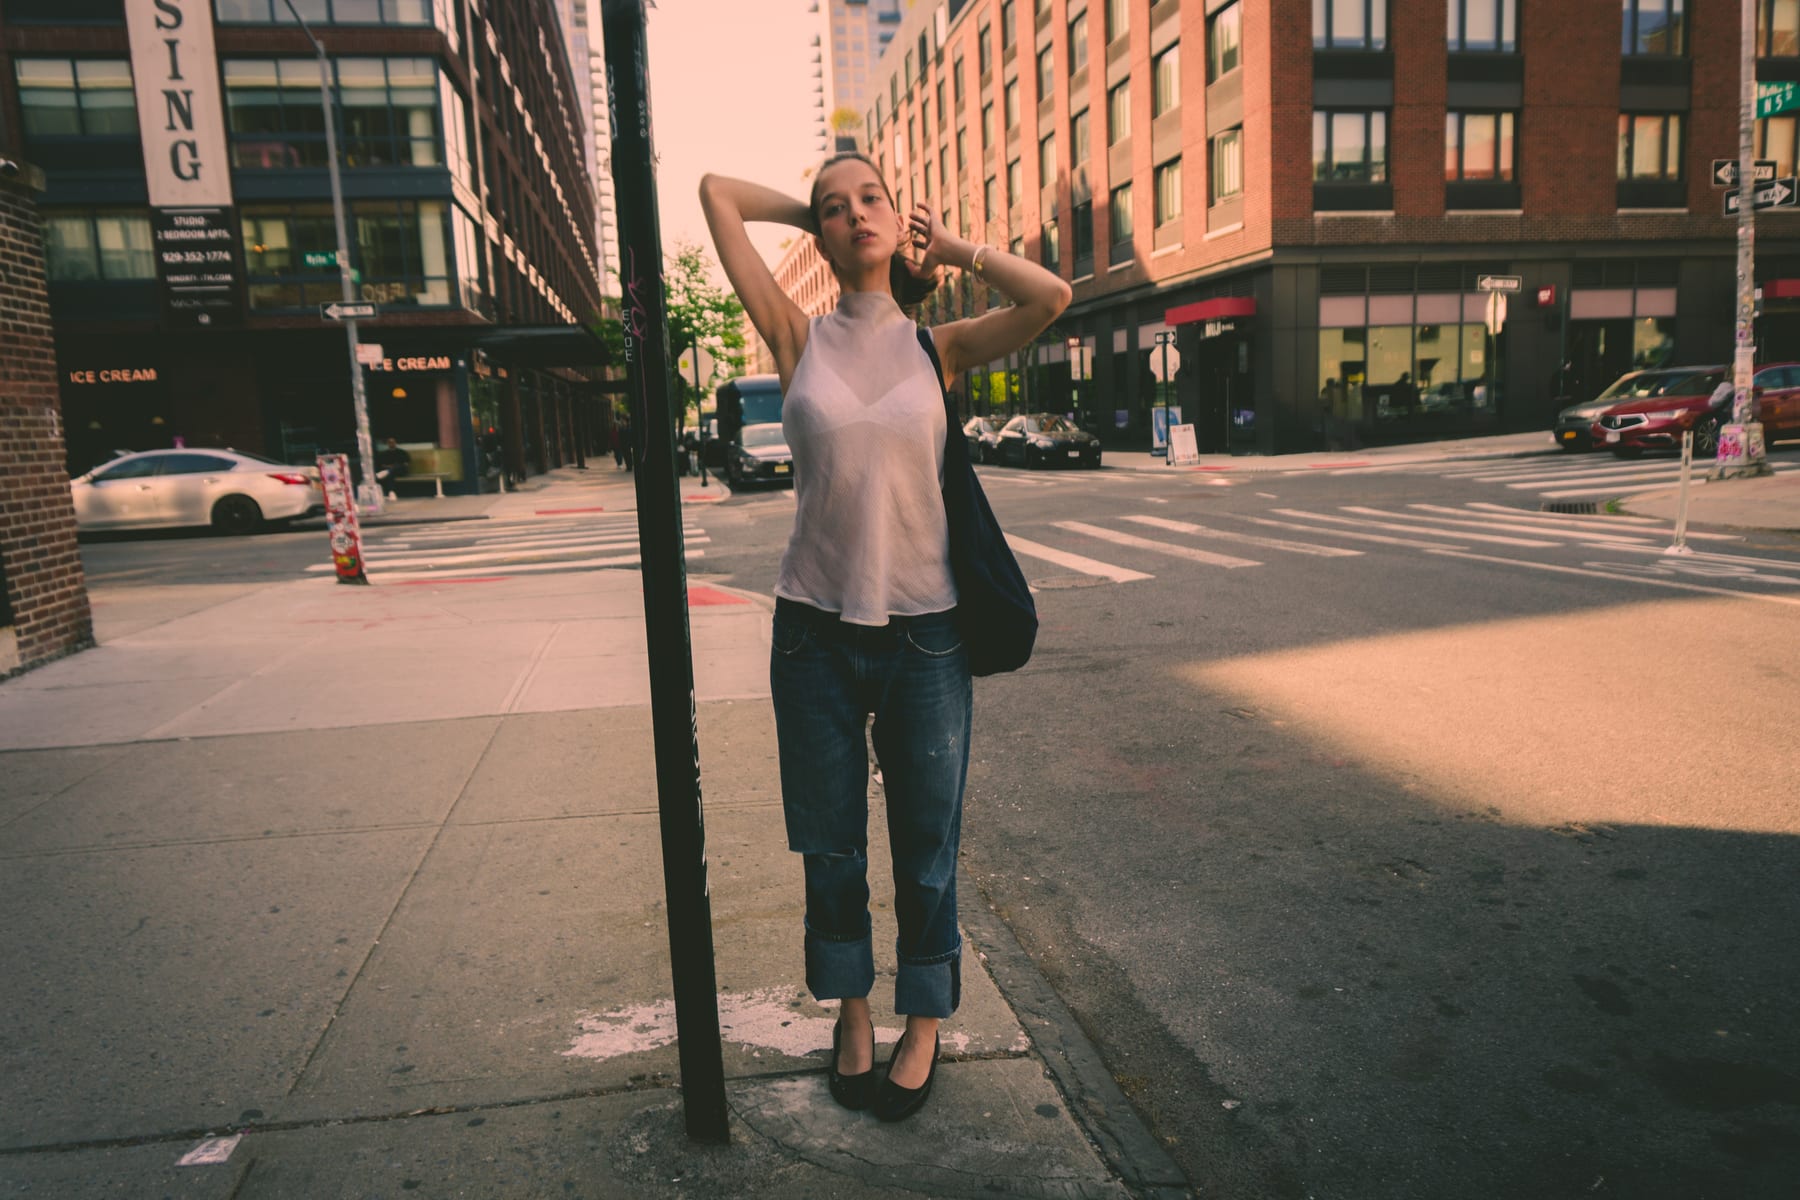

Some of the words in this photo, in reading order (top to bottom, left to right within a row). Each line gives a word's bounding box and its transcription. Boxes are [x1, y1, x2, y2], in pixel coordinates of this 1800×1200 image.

[154, 0, 202, 181] SING
[1776, 94, 1783, 111] 5
[1724, 167, 1739, 178] ON
[1763, 187, 1785, 201] WAY
[396, 356, 451, 371] CREAM
[70, 371, 95, 383] ICE
[99, 367, 157, 382] CREAM
